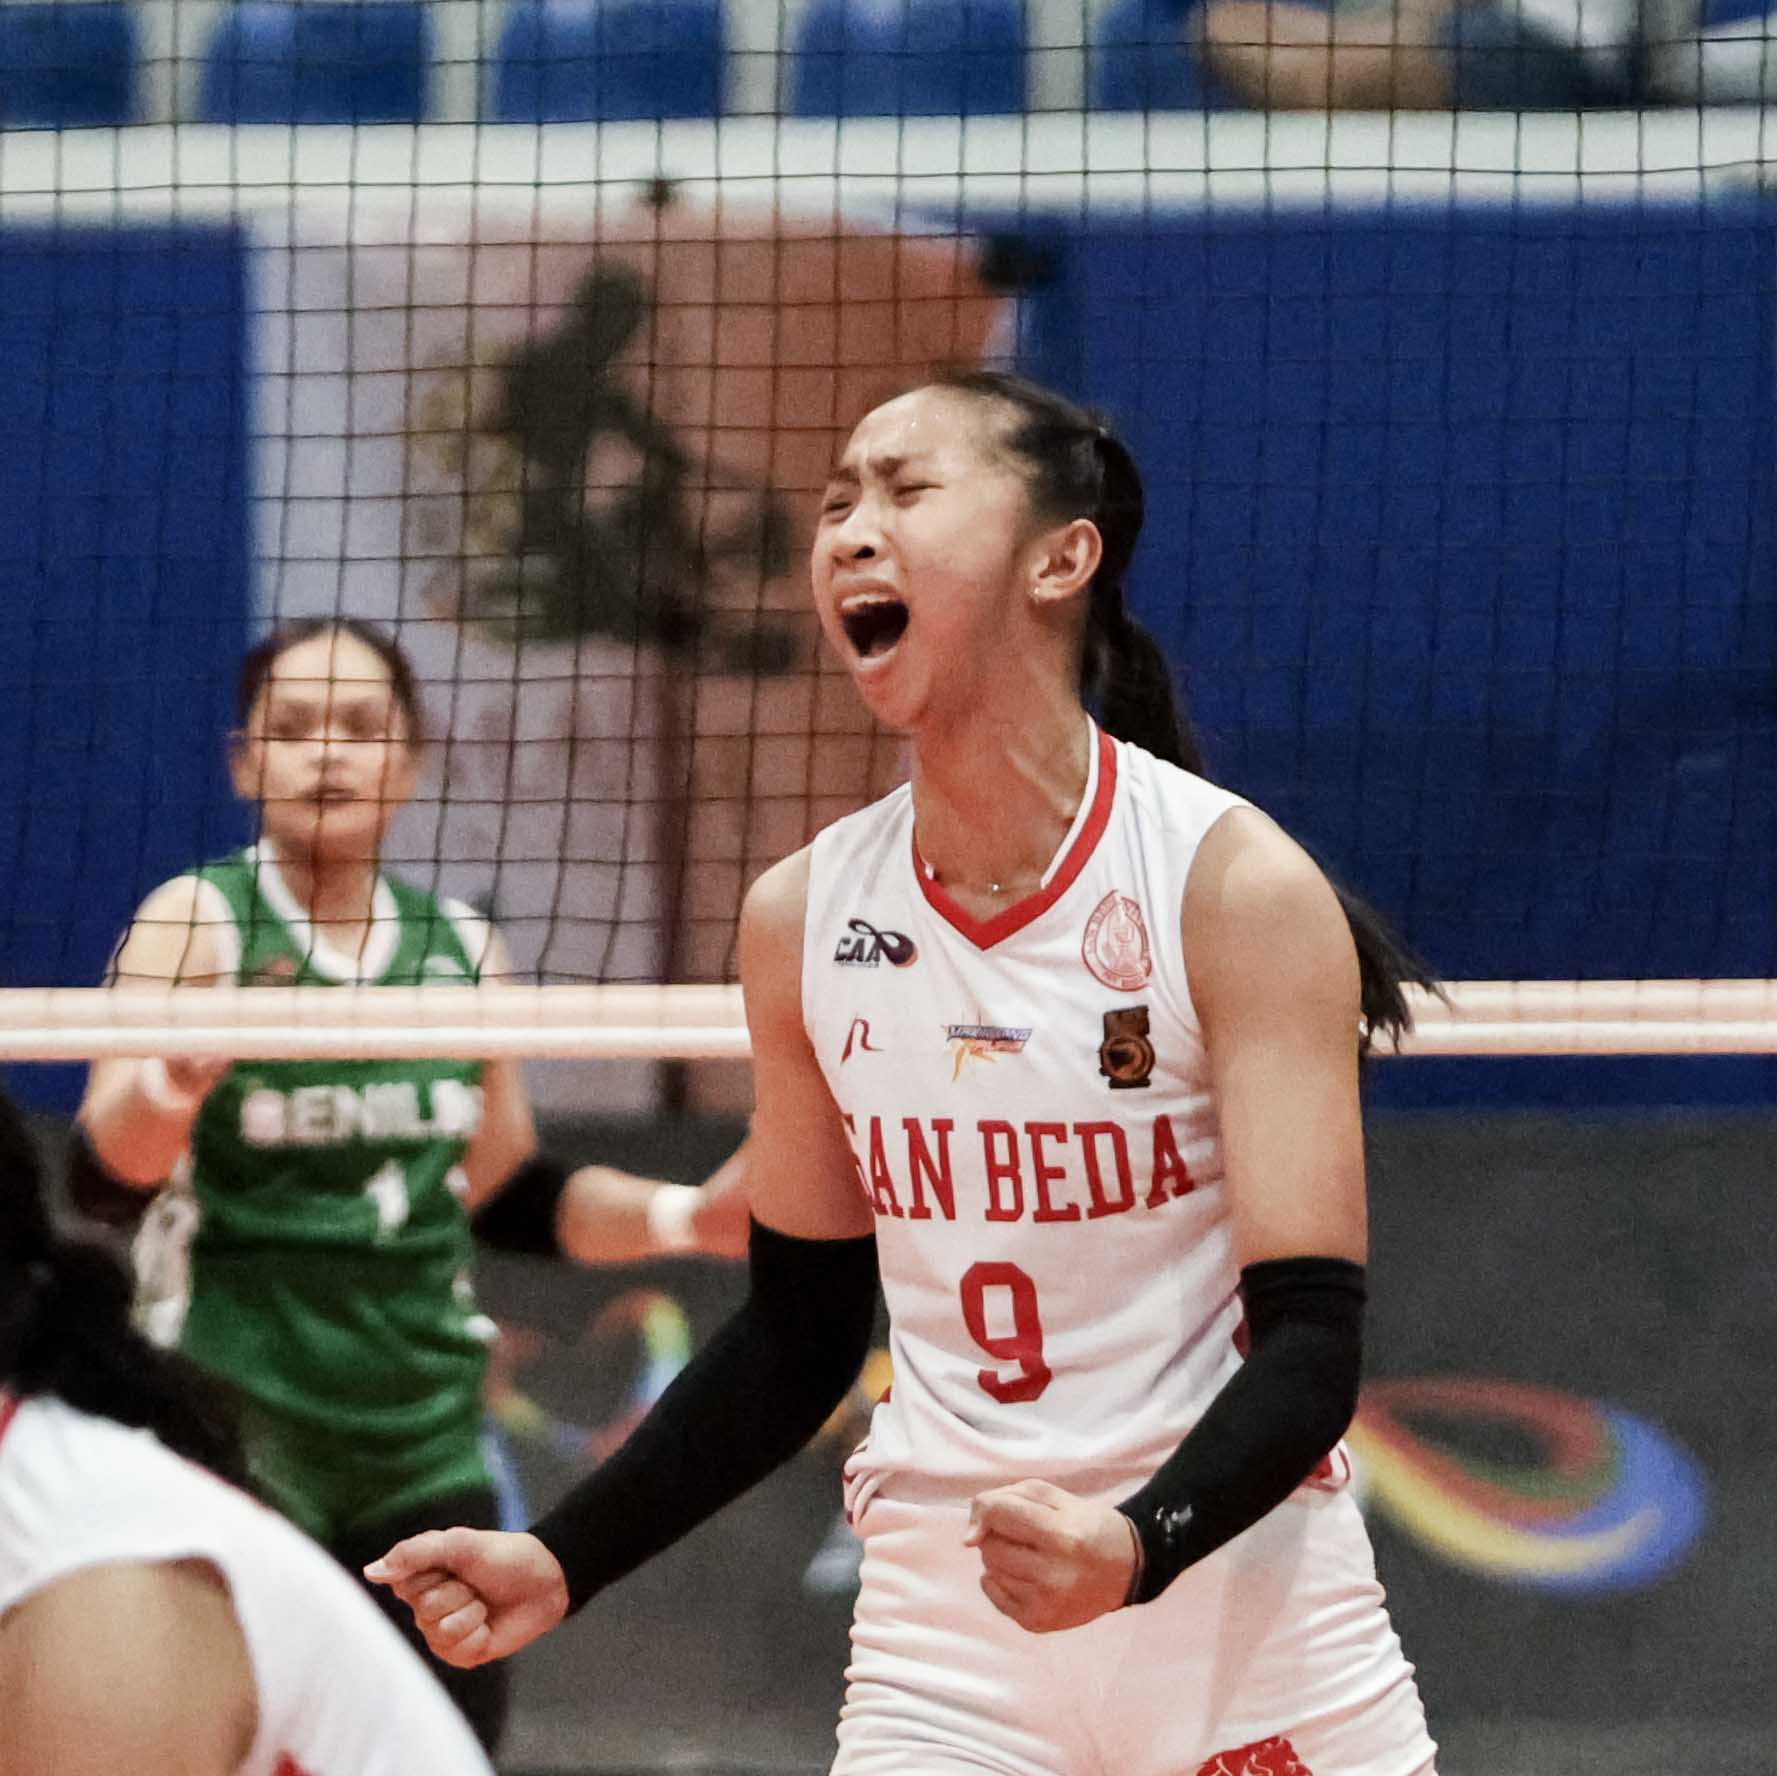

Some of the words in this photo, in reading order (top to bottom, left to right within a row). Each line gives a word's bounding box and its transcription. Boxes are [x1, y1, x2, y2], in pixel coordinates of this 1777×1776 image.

[842, 1113, 958, 1222] AN
[976, 1113, 1196, 1224] BEDA
[959, 1261, 1053, 1405] 9
